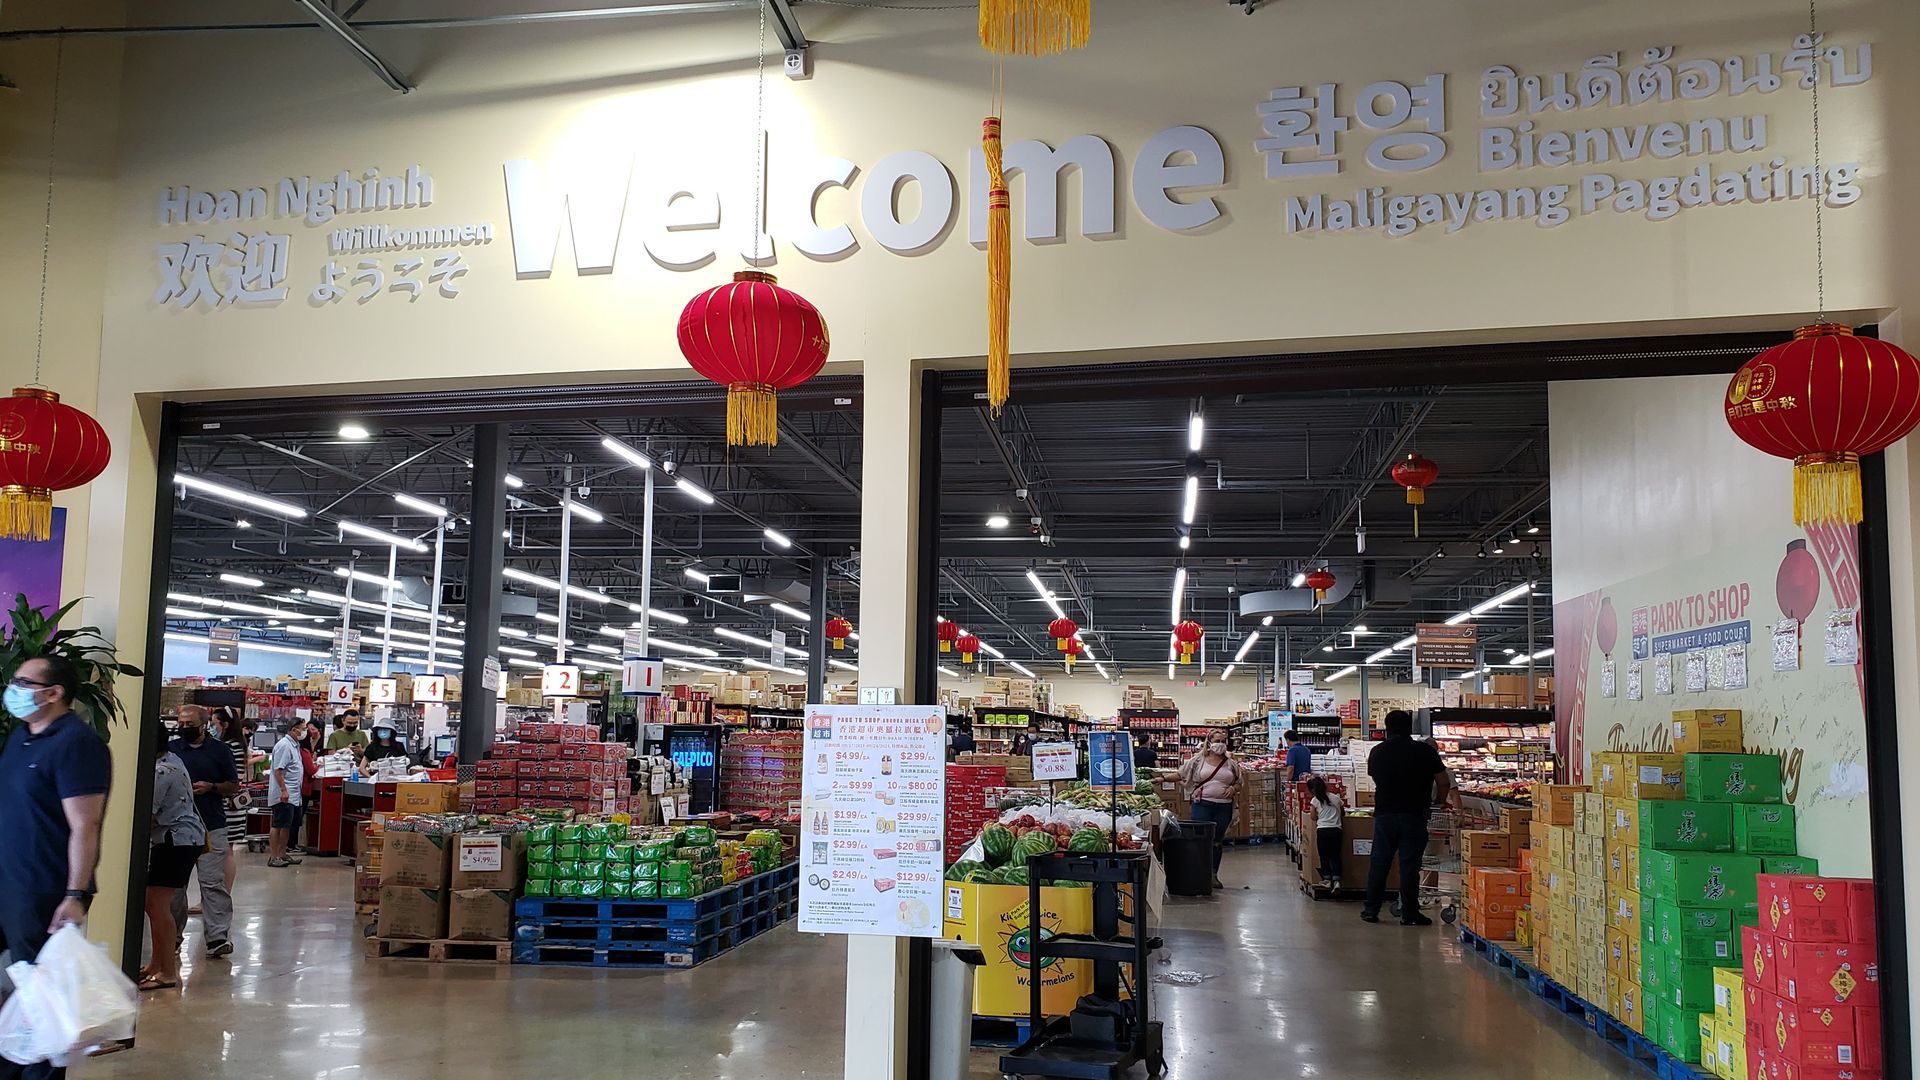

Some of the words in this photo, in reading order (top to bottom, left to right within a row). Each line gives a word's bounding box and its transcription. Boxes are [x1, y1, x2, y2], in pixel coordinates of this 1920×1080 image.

[1480, 33, 1873, 119] ยินดีต้อนรับ
[1256, 71, 1447, 179] 환영
[1480, 113, 1768, 174] Bienvenu
[159, 186, 268, 226] Hoan
[277, 163, 434, 228] Nghinh
[501, 122, 1227, 281] Welcome
[1286, 181, 1572, 237] Maligayang
[1580, 156, 1863, 224] Pagdating
[328, 219, 494, 257] Willkommen
[154, 231, 292, 308] 欢迎
[309, 250, 471, 303] ようこそ
[1650, 598, 1684, 634] PARK
[1686, 594, 1705, 627] TO
[1708, 583, 1750, 623] SHOP
[1462, 627, 1475, 638] 5
[1654, 635, 1695, 653] SUPERMARKET
[1704, 632, 1722, 644] FOOD
[1724, 626, 1748, 641] COURT
[338, 685, 348, 699] 6
[381, 683, 390, 698] 5
[427, 681, 438, 697] 4
[559, 671, 571, 689] 2
[672, 751, 713, 767] CALPICO
[849, 781, 873, 790] $9.99
[887, 781, 898, 790] 10
[908, 781, 938, 791] $80.00
